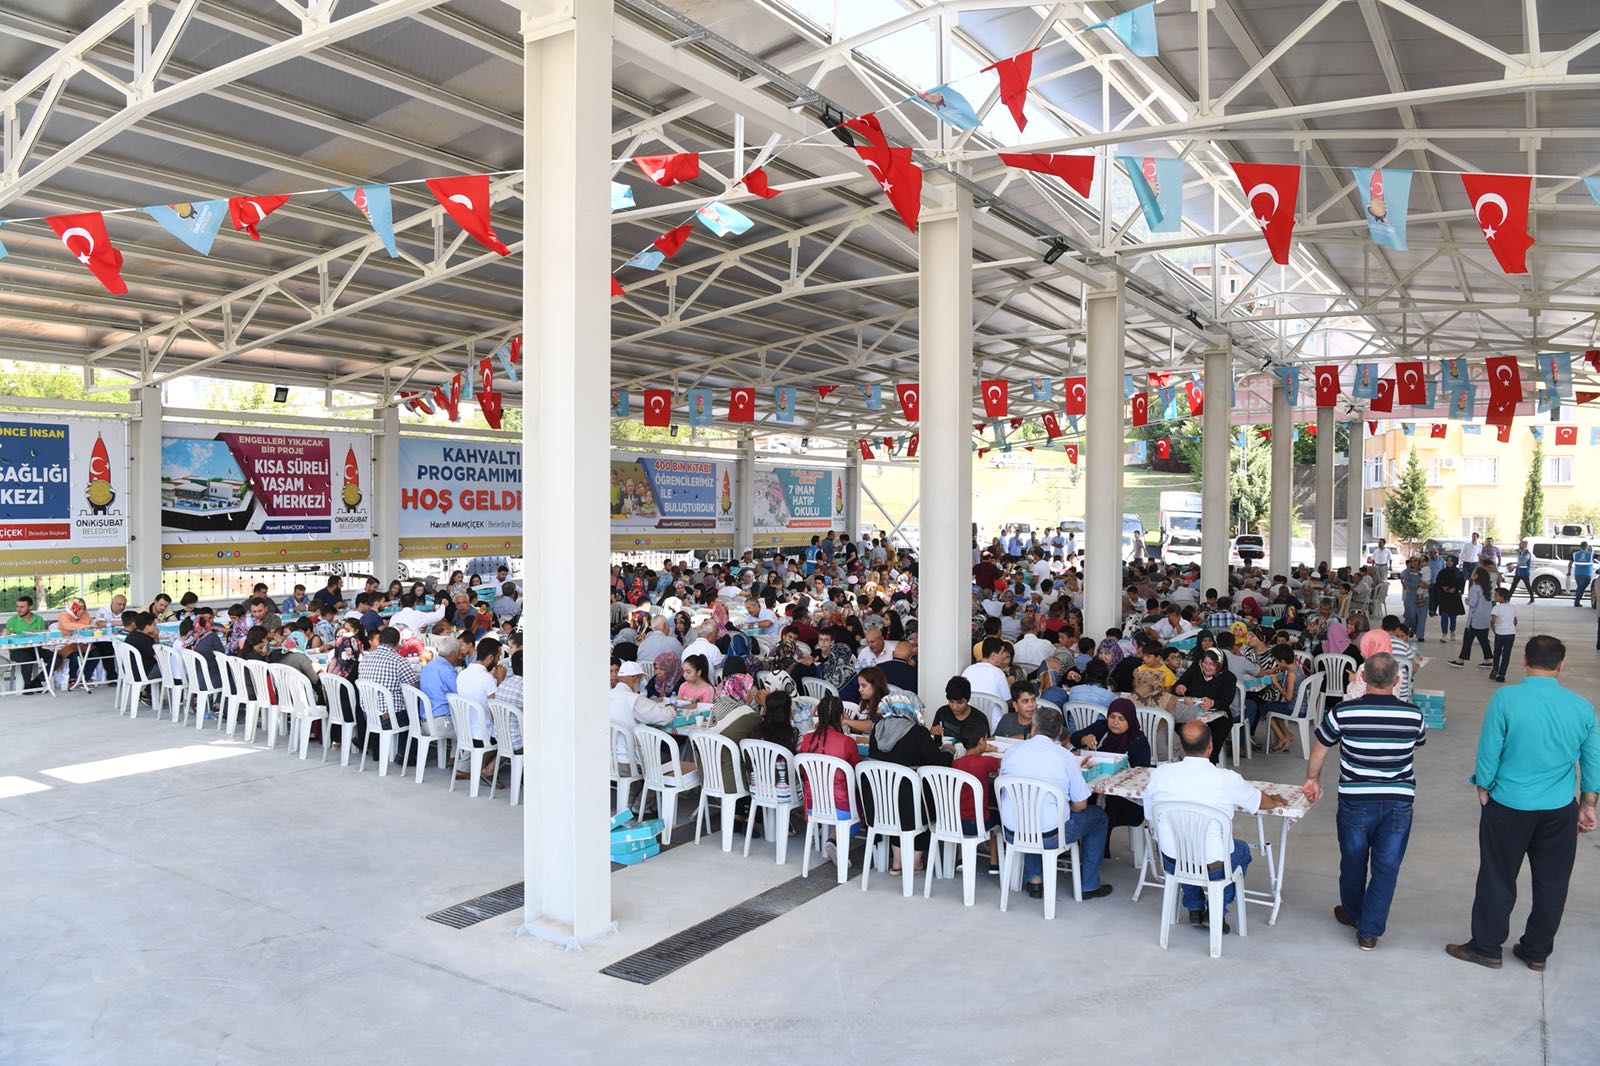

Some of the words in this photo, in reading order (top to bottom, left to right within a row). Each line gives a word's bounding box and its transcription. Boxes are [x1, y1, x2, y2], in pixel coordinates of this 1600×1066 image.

[0, 427, 27, 437] NCE
[29, 426, 65, 439] İNSAN
[239, 435, 286, 446] ENGELLERİ
[287, 438, 324, 447] YIKACAK
[261, 445, 276, 454] BİR
[442, 447, 520, 465] KAHVALTI
[254, 459, 285, 474] KISA
[287, 457, 329, 475] SÜRELİ
[655, 460, 671, 471] 400
[260, 476, 304, 493] YAŞAM
[655, 473, 714, 488] ÖĞRENCİLERİMİZ
[0, 485, 45, 505] KEZİ
[660, 486, 673, 499] İLE
[788, 485, 794, 495] 7
[272, 492, 326, 509] MERKEZİ
[401, 488, 453, 514] HOŞ
[664, 502, 715, 515] BULUŞTURDUK
[794, 506, 819, 516] OKULU
